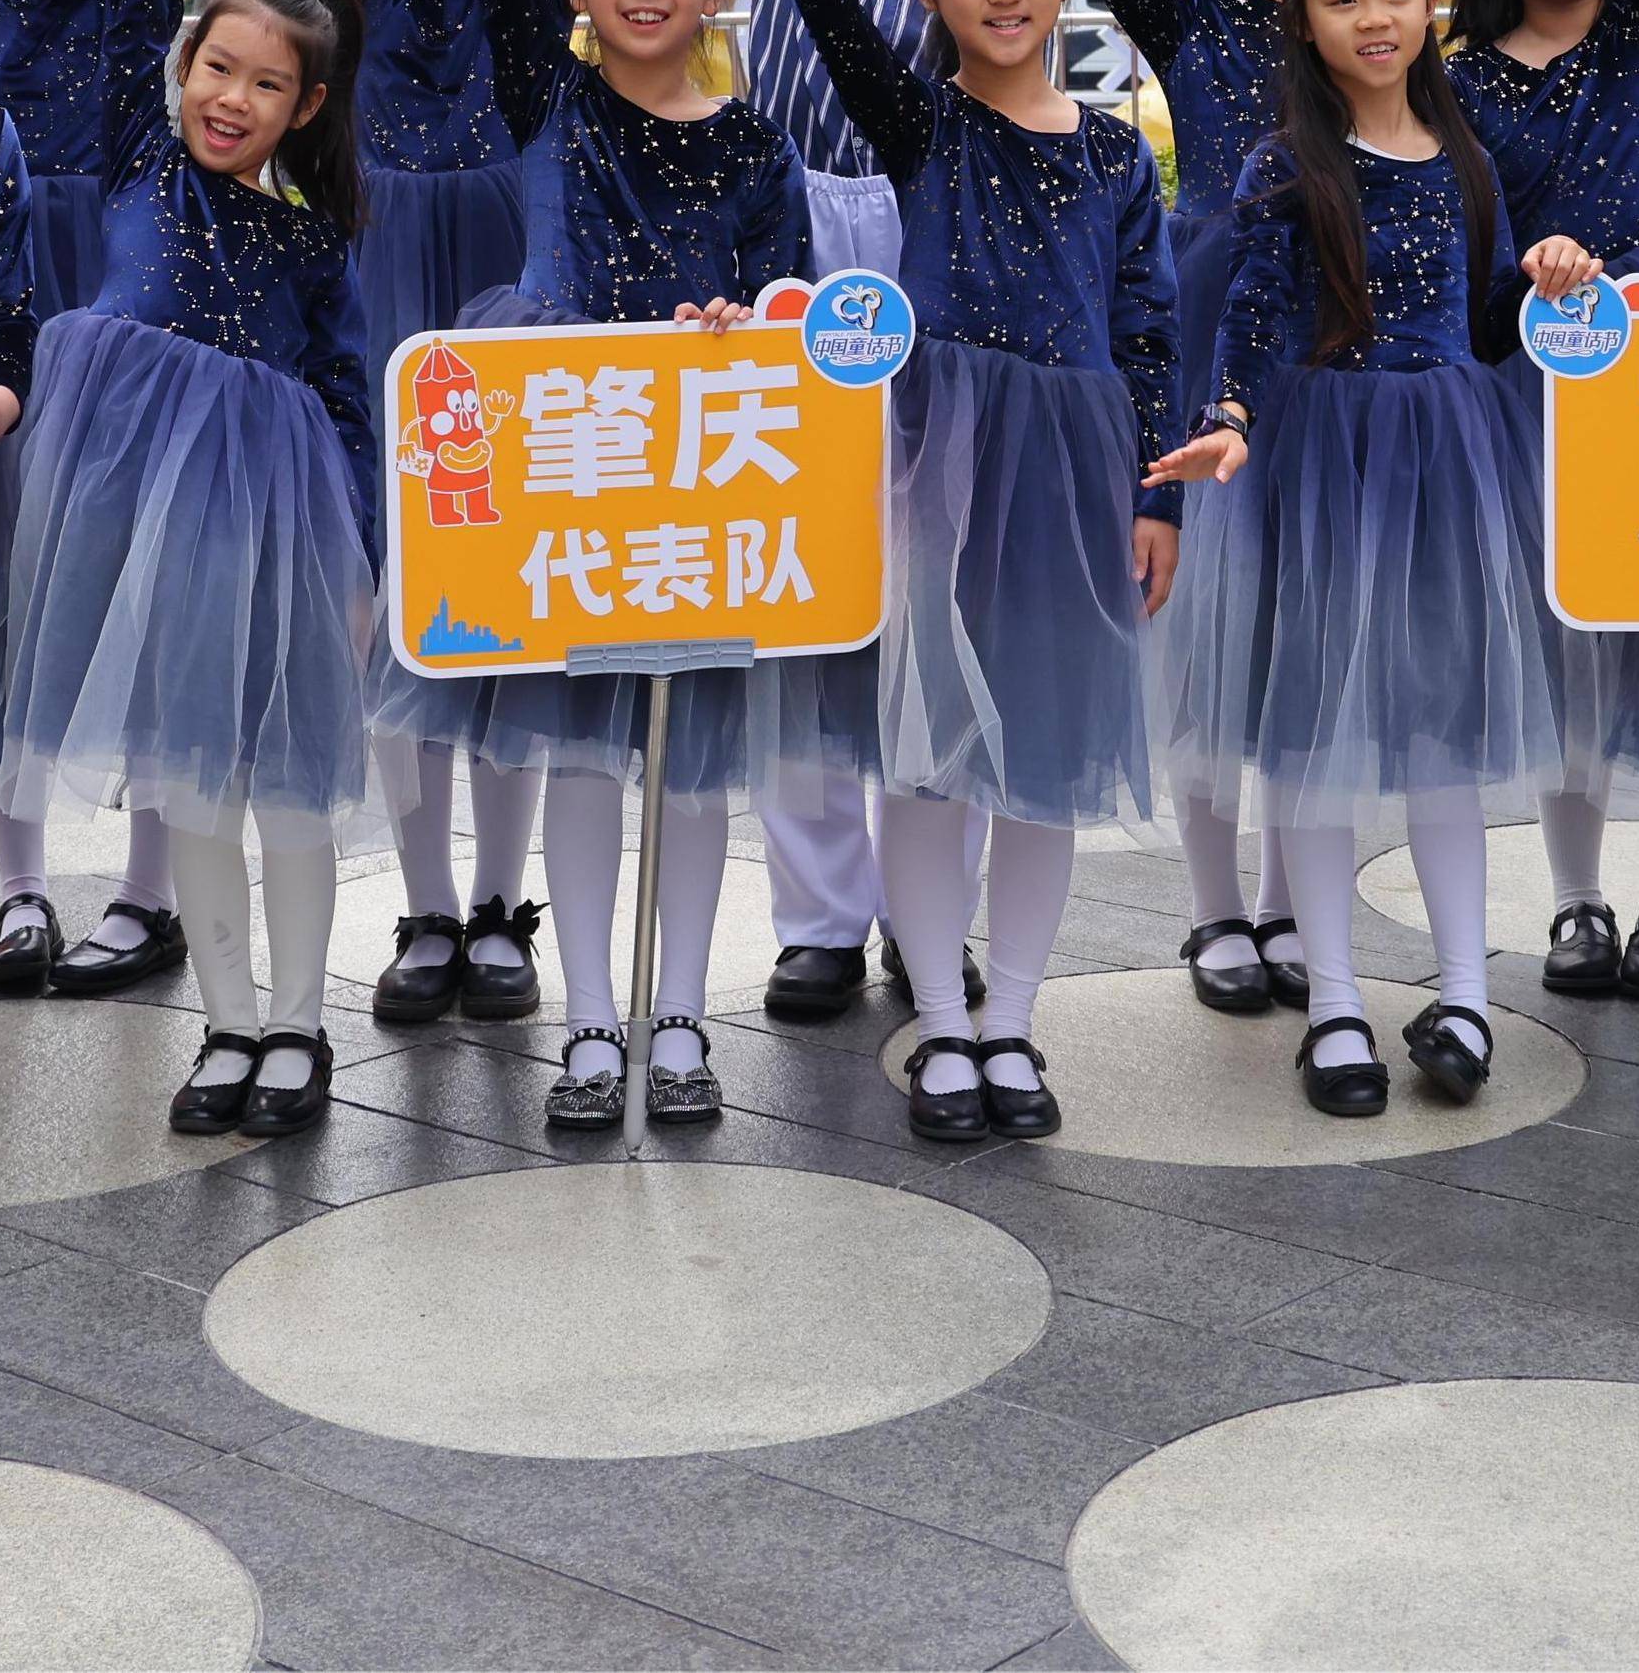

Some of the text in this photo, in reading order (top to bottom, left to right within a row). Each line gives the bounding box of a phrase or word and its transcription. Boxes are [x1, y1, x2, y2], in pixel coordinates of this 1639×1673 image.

[815, 336, 901, 358] 中国童话节
[1534, 330, 1618, 352] 中国童话节
[520, 358, 800, 497] 肇庆
[518, 516, 816, 620] 代表队
